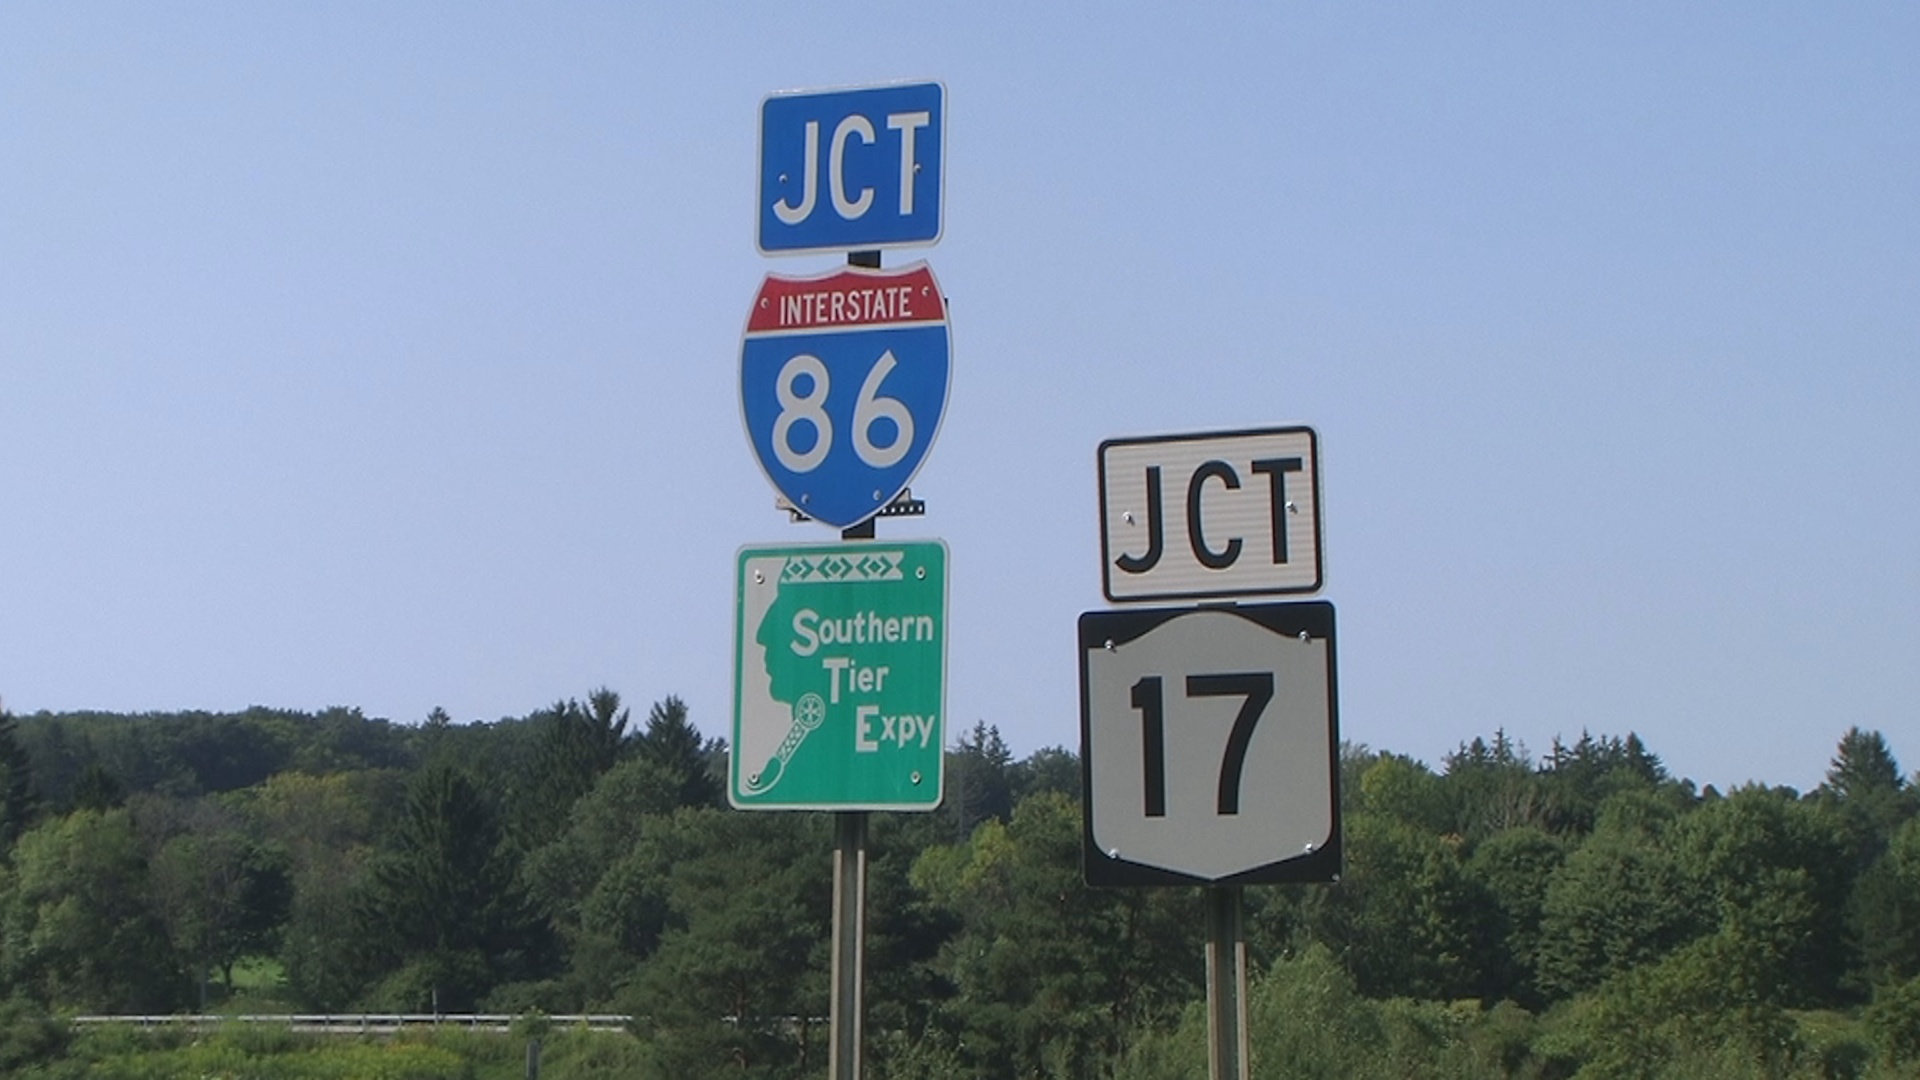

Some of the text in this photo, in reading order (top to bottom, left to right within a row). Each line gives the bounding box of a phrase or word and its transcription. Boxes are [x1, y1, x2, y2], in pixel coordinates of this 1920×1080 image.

[772, 111, 930, 225] JCT
[780, 287, 912, 325] INTERSTATE
[772, 350, 914, 473] 86
[1114, 457, 1303, 574] JCT
[790, 608, 934, 657] Southern
[822, 657, 889, 704] Tier
[855, 705, 935, 753] Expy
[1130, 671, 1275, 818] 17
